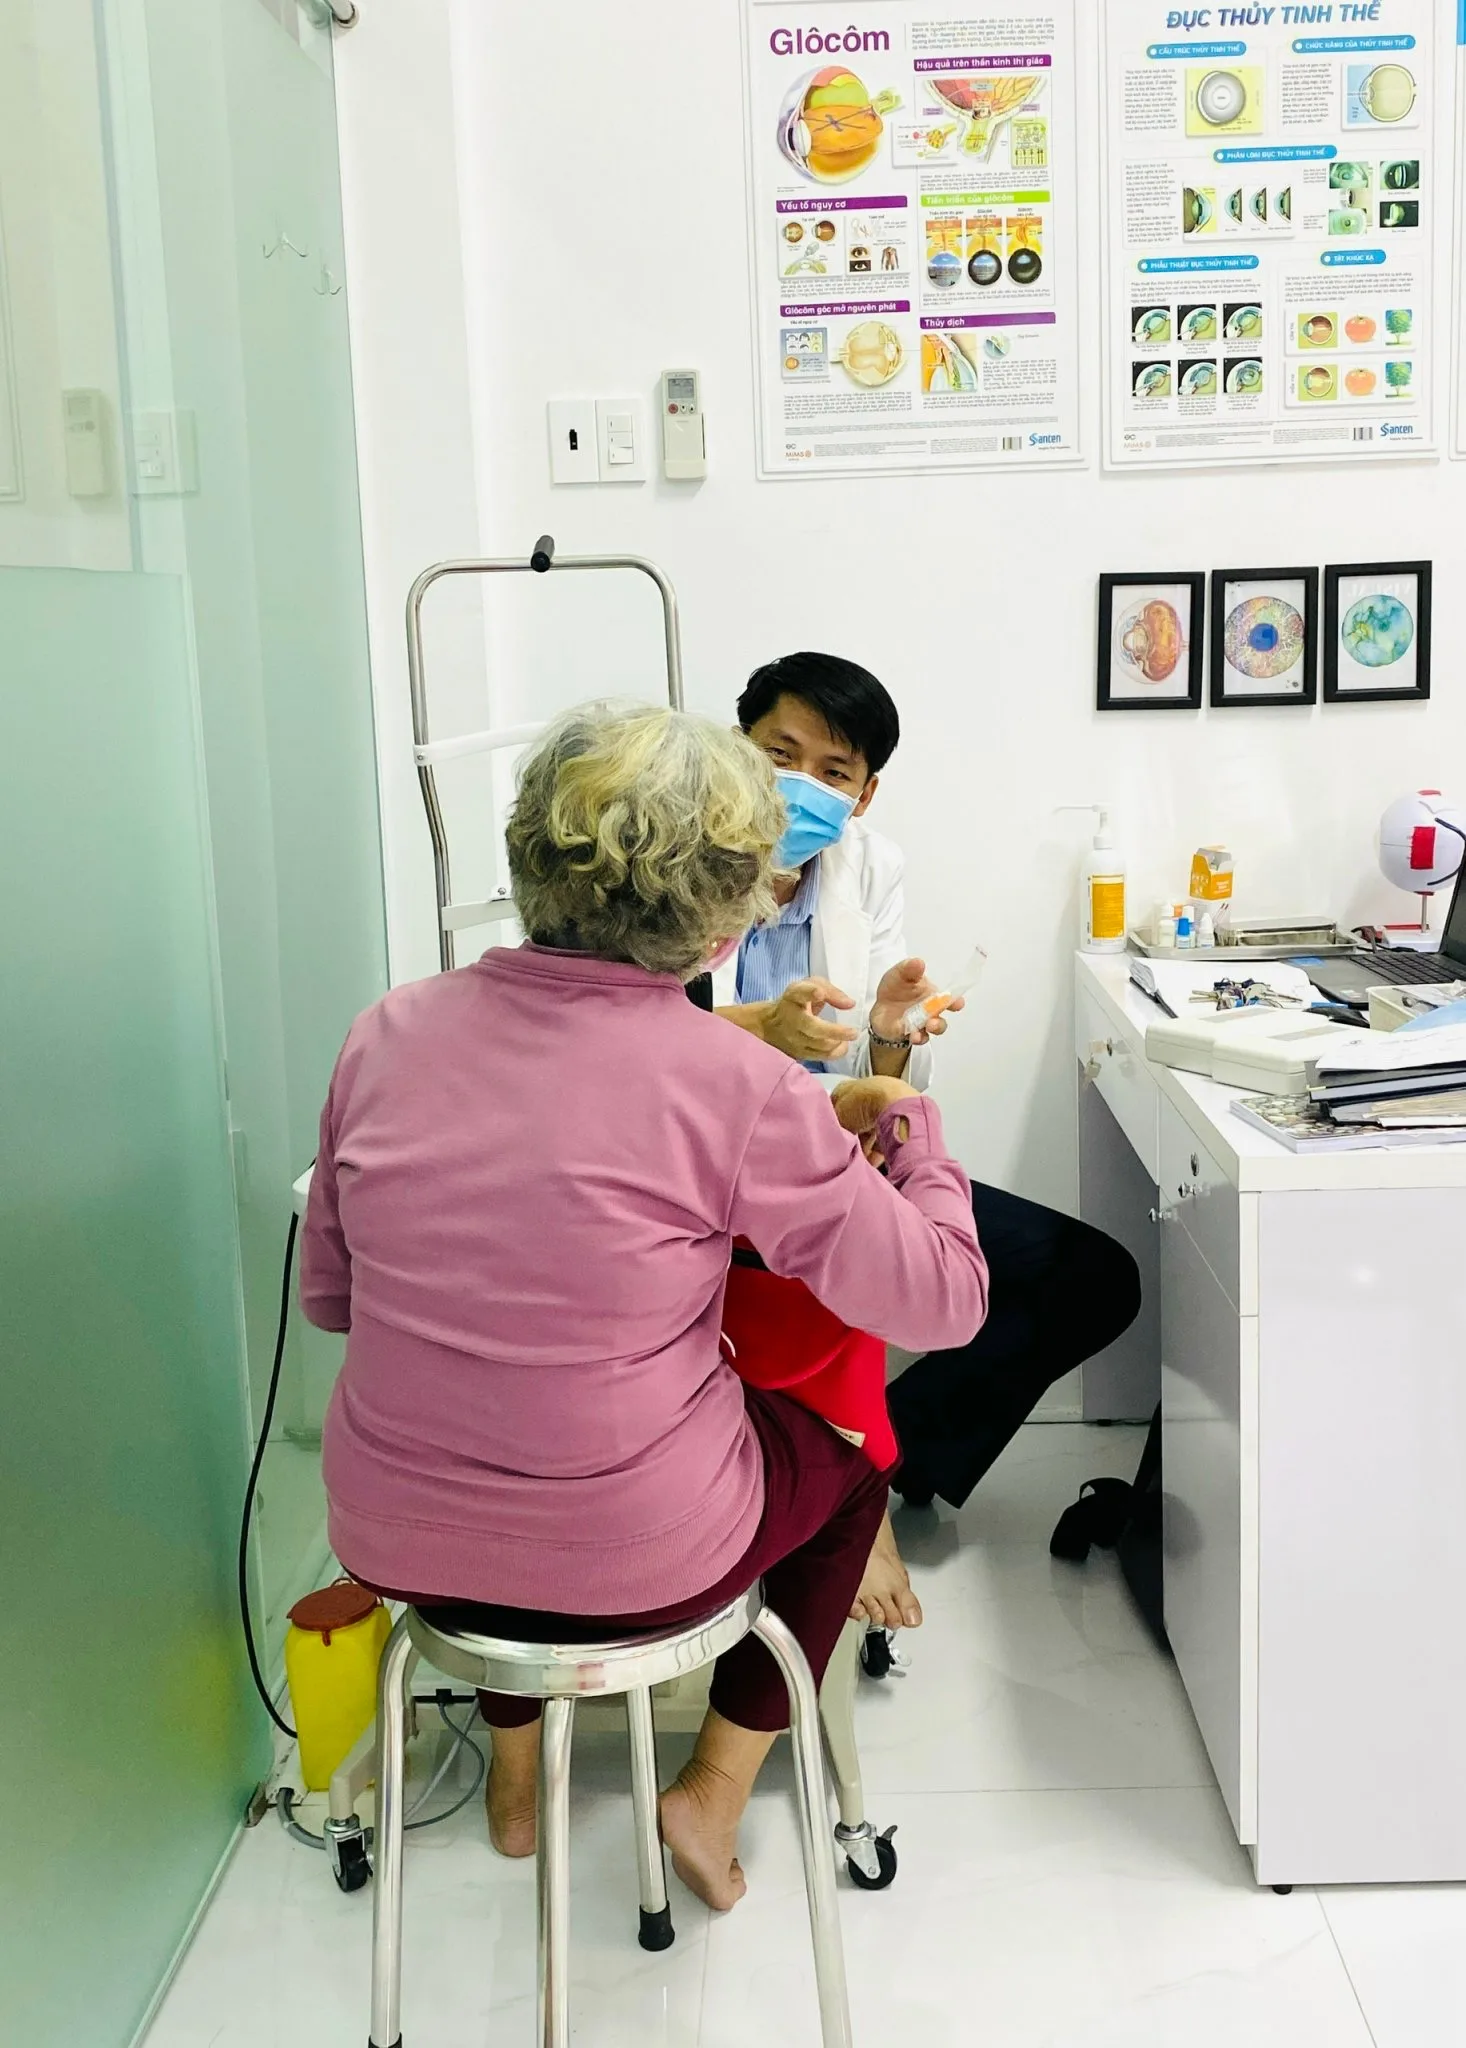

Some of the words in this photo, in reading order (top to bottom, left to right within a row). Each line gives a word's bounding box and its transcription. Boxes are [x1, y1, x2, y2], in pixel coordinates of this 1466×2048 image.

[1166, 9, 1212, 32] ĐỤC
[1218, 1, 1275, 27] THỦY
[1281, 5, 1333, 25] TINH
[1339, 0, 1383, 22] THỂ
[769, 24, 890, 56] Glôcôm
[916, 61, 933, 70] Hậu
[935, 59, 950, 70] quả
[952, 58, 970, 68] trên
[971, 58, 990, 67] thần
[992, 57, 1011, 66] kinh
[1013, 57, 1024, 67] thị
[1026, 57, 1044, 67] giác
[781, 201, 798, 210] Yếu
[800, 200, 809, 210] tố
[811, 202, 833, 212] nguy
[834, 200, 847, 209] cơ
[784, 306, 815, 315] Glôcôm
[816, 305, 832, 316] góc
[833, 304, 846, 313] mở
[847, 304, 877, 314] nguyên
[878, 302, 897, 312] phát
[924, 317, 945, 328] Thủy
[946, 317, 965, 328] dịch
[1380, 422, 1413, 437] Santen
[1028, 432, 1062, 447] Santen
